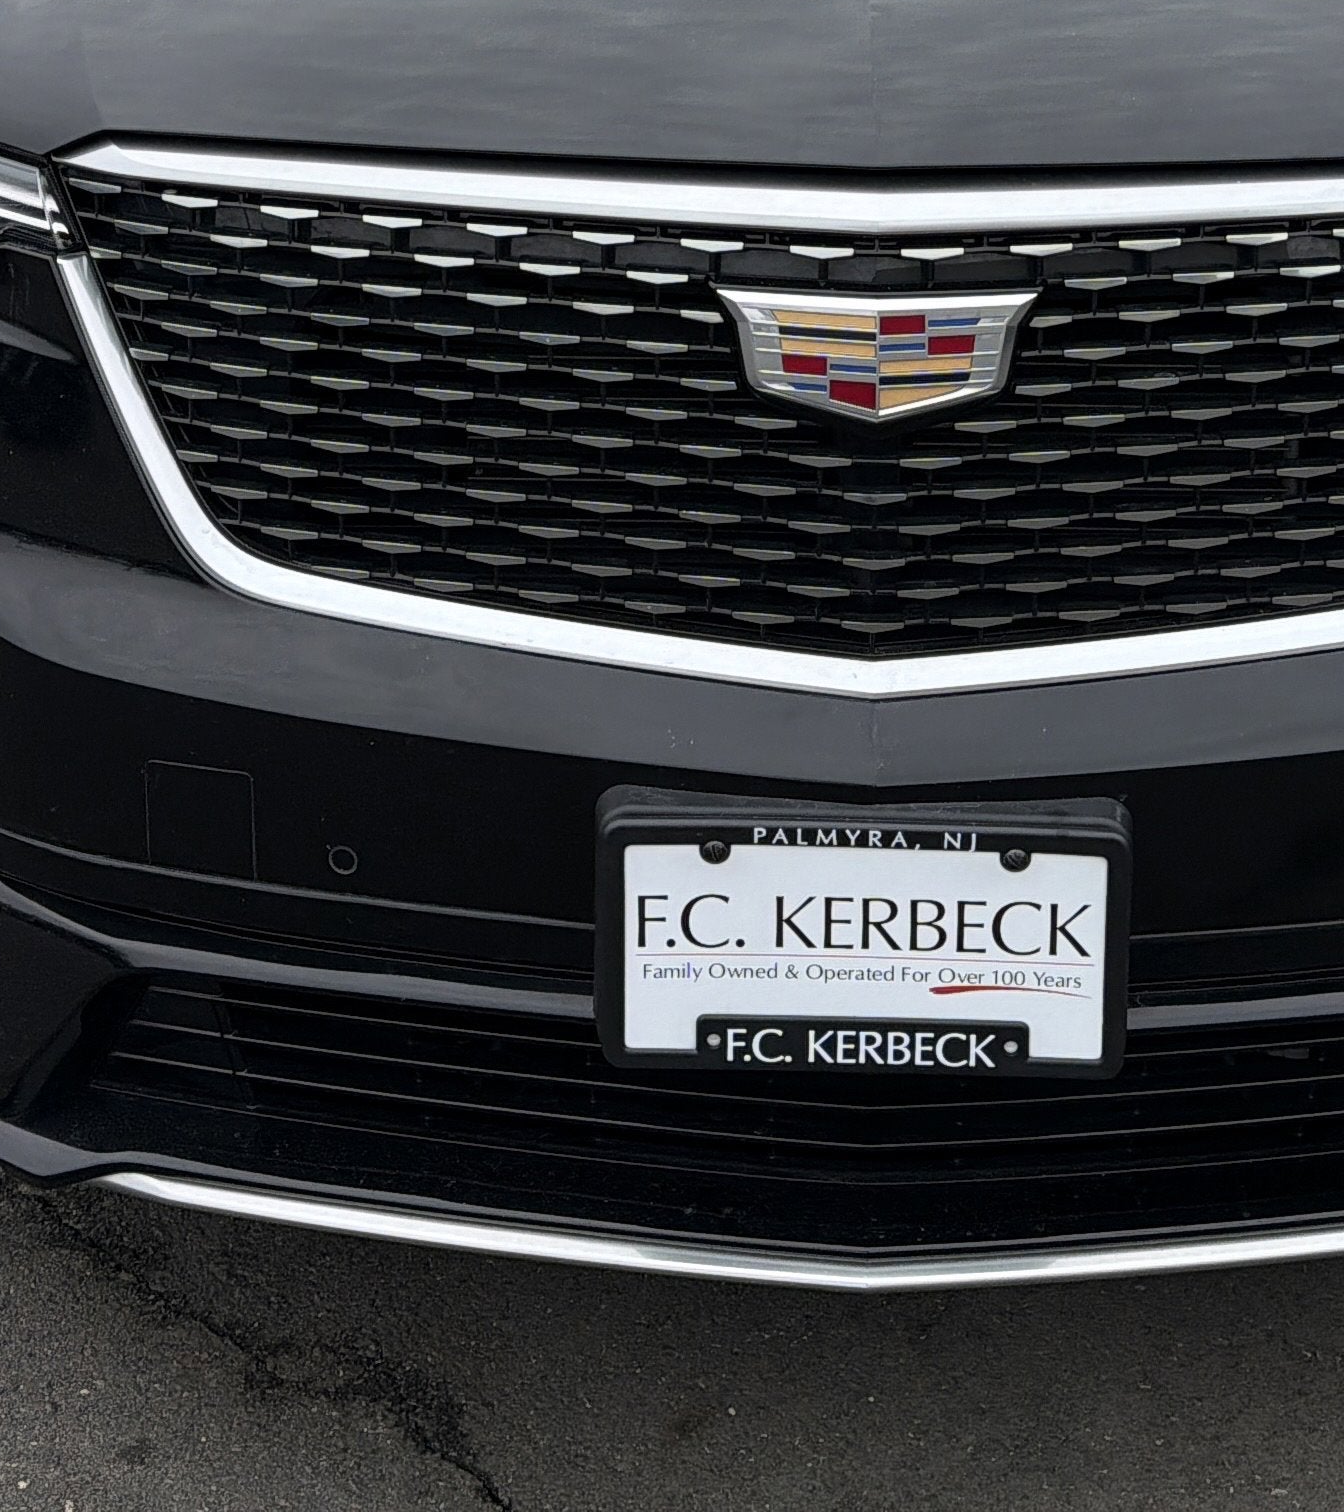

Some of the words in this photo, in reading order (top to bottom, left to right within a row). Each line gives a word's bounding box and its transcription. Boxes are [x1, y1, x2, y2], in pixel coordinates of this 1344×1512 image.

[753, 827, 921, 851] PALMYRA,
[943, 832, 977, 852] NJ
[637, 893, 746, 949] F.C.
[775, 895, 1092, 958] KERBECK
[642, 961, 703, 983] Family
[708, 961, 778, 979] Owned
[784, 963, 799, 979] &
[805, 963, 895, 983] Operated
[901, 966, 932, 983] For
[938, 967, 985, 985] Over
[991, 970, 1026, 986] 100
[1032, 971, 1082, 989] Years
[725, 1028, 793, 1065] F.C.
[807, 1030, 997, 1070] KERBECK
